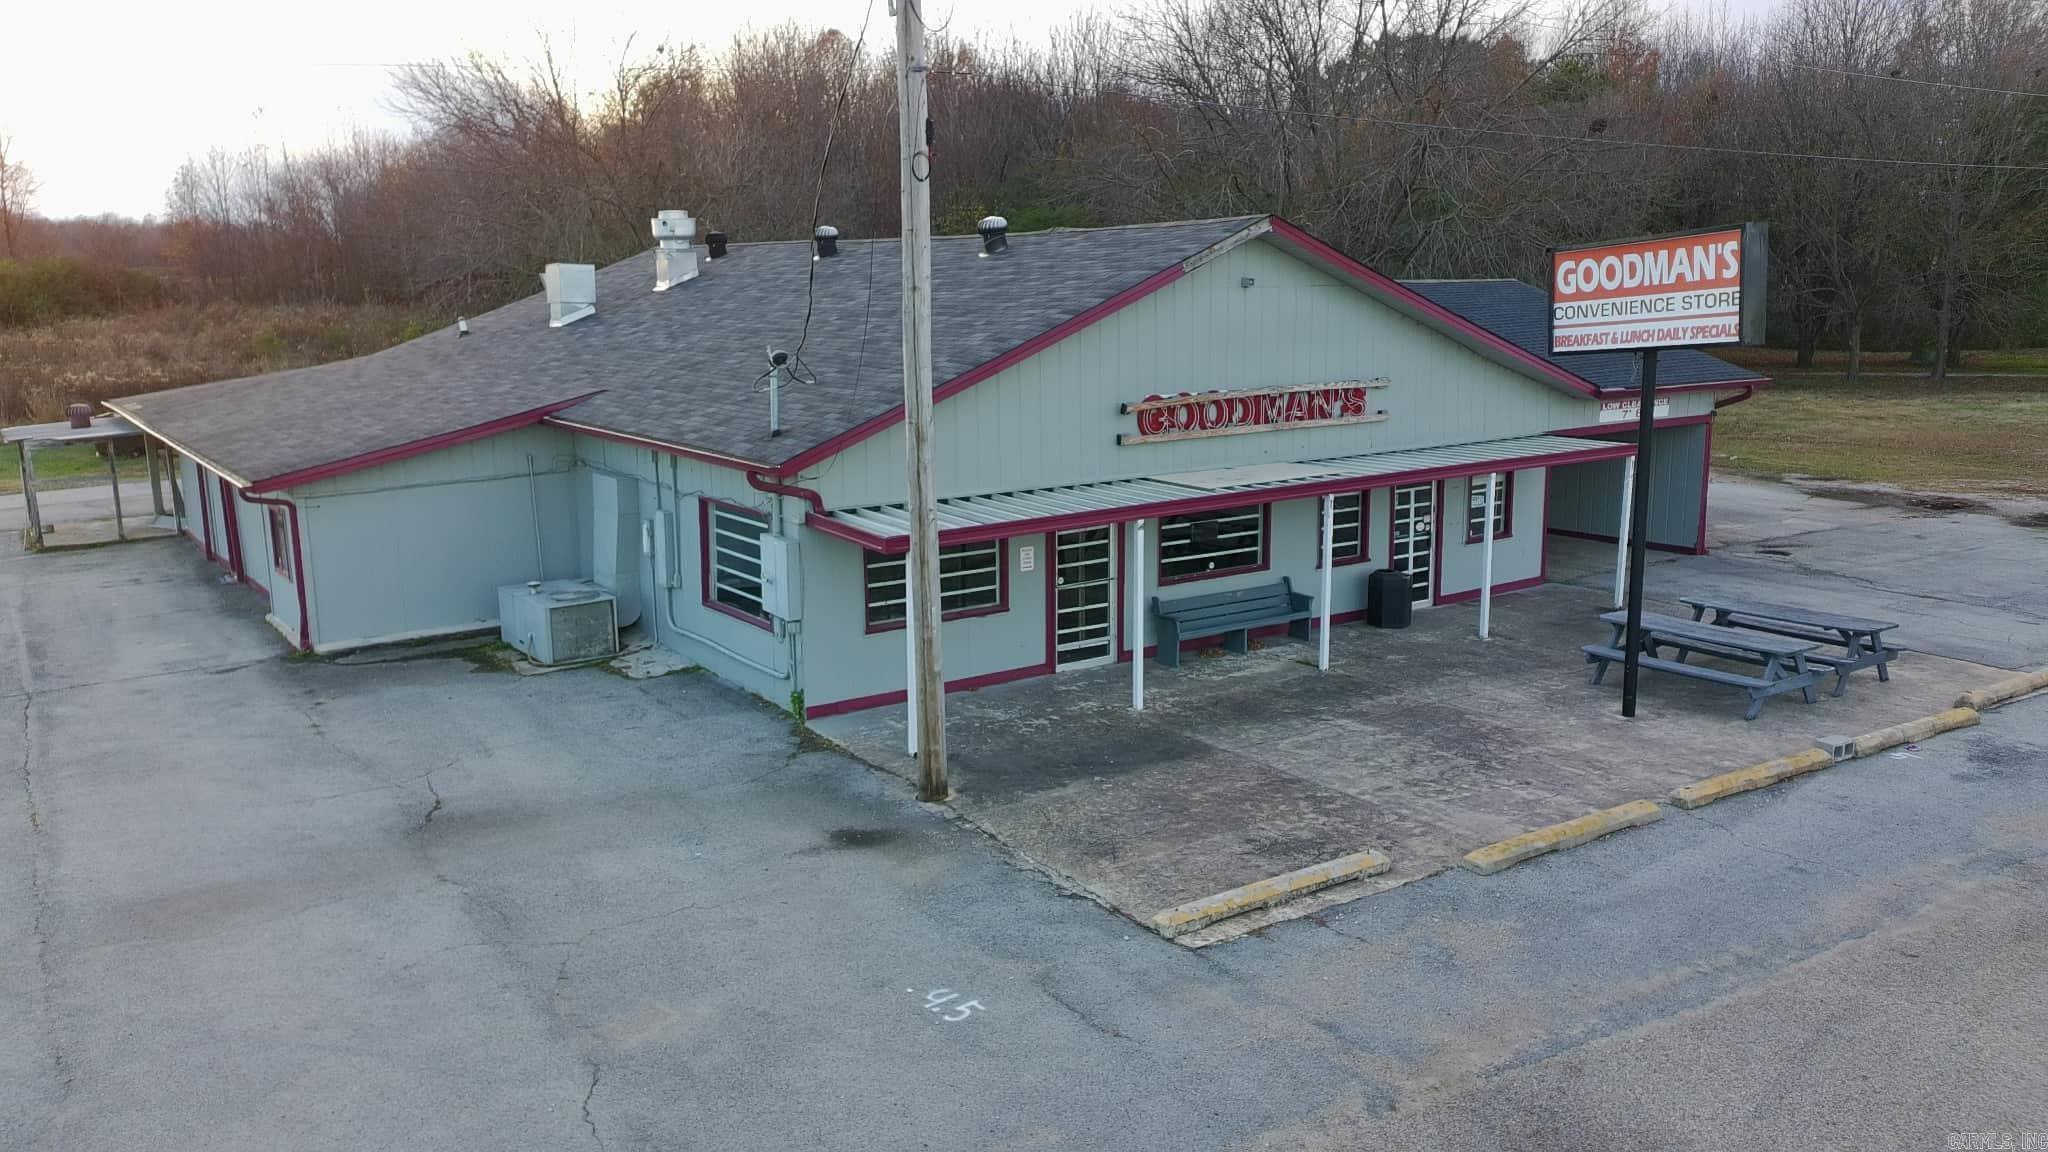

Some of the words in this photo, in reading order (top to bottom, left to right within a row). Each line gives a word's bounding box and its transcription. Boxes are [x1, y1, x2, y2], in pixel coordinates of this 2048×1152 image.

[1557, 241, 1738, 294] GOODMAN'S
[1554, 297, 1675, 320] CONVENIENCE
[1681, 290, 1740, 310] STORE
[1554, 332, 1610, 347] BREAKFAST
[1611, 332, 1619, 345] &
[1620, 328, 1655, 344] LUNCH
[1657, 326, 1688, 341] DAILY
[1690, 323, 1739, 338] SPECIALS
[1137, 386, 1366, 435] GOODMAN'S
[1602, 402, 1620, 410] LOW
